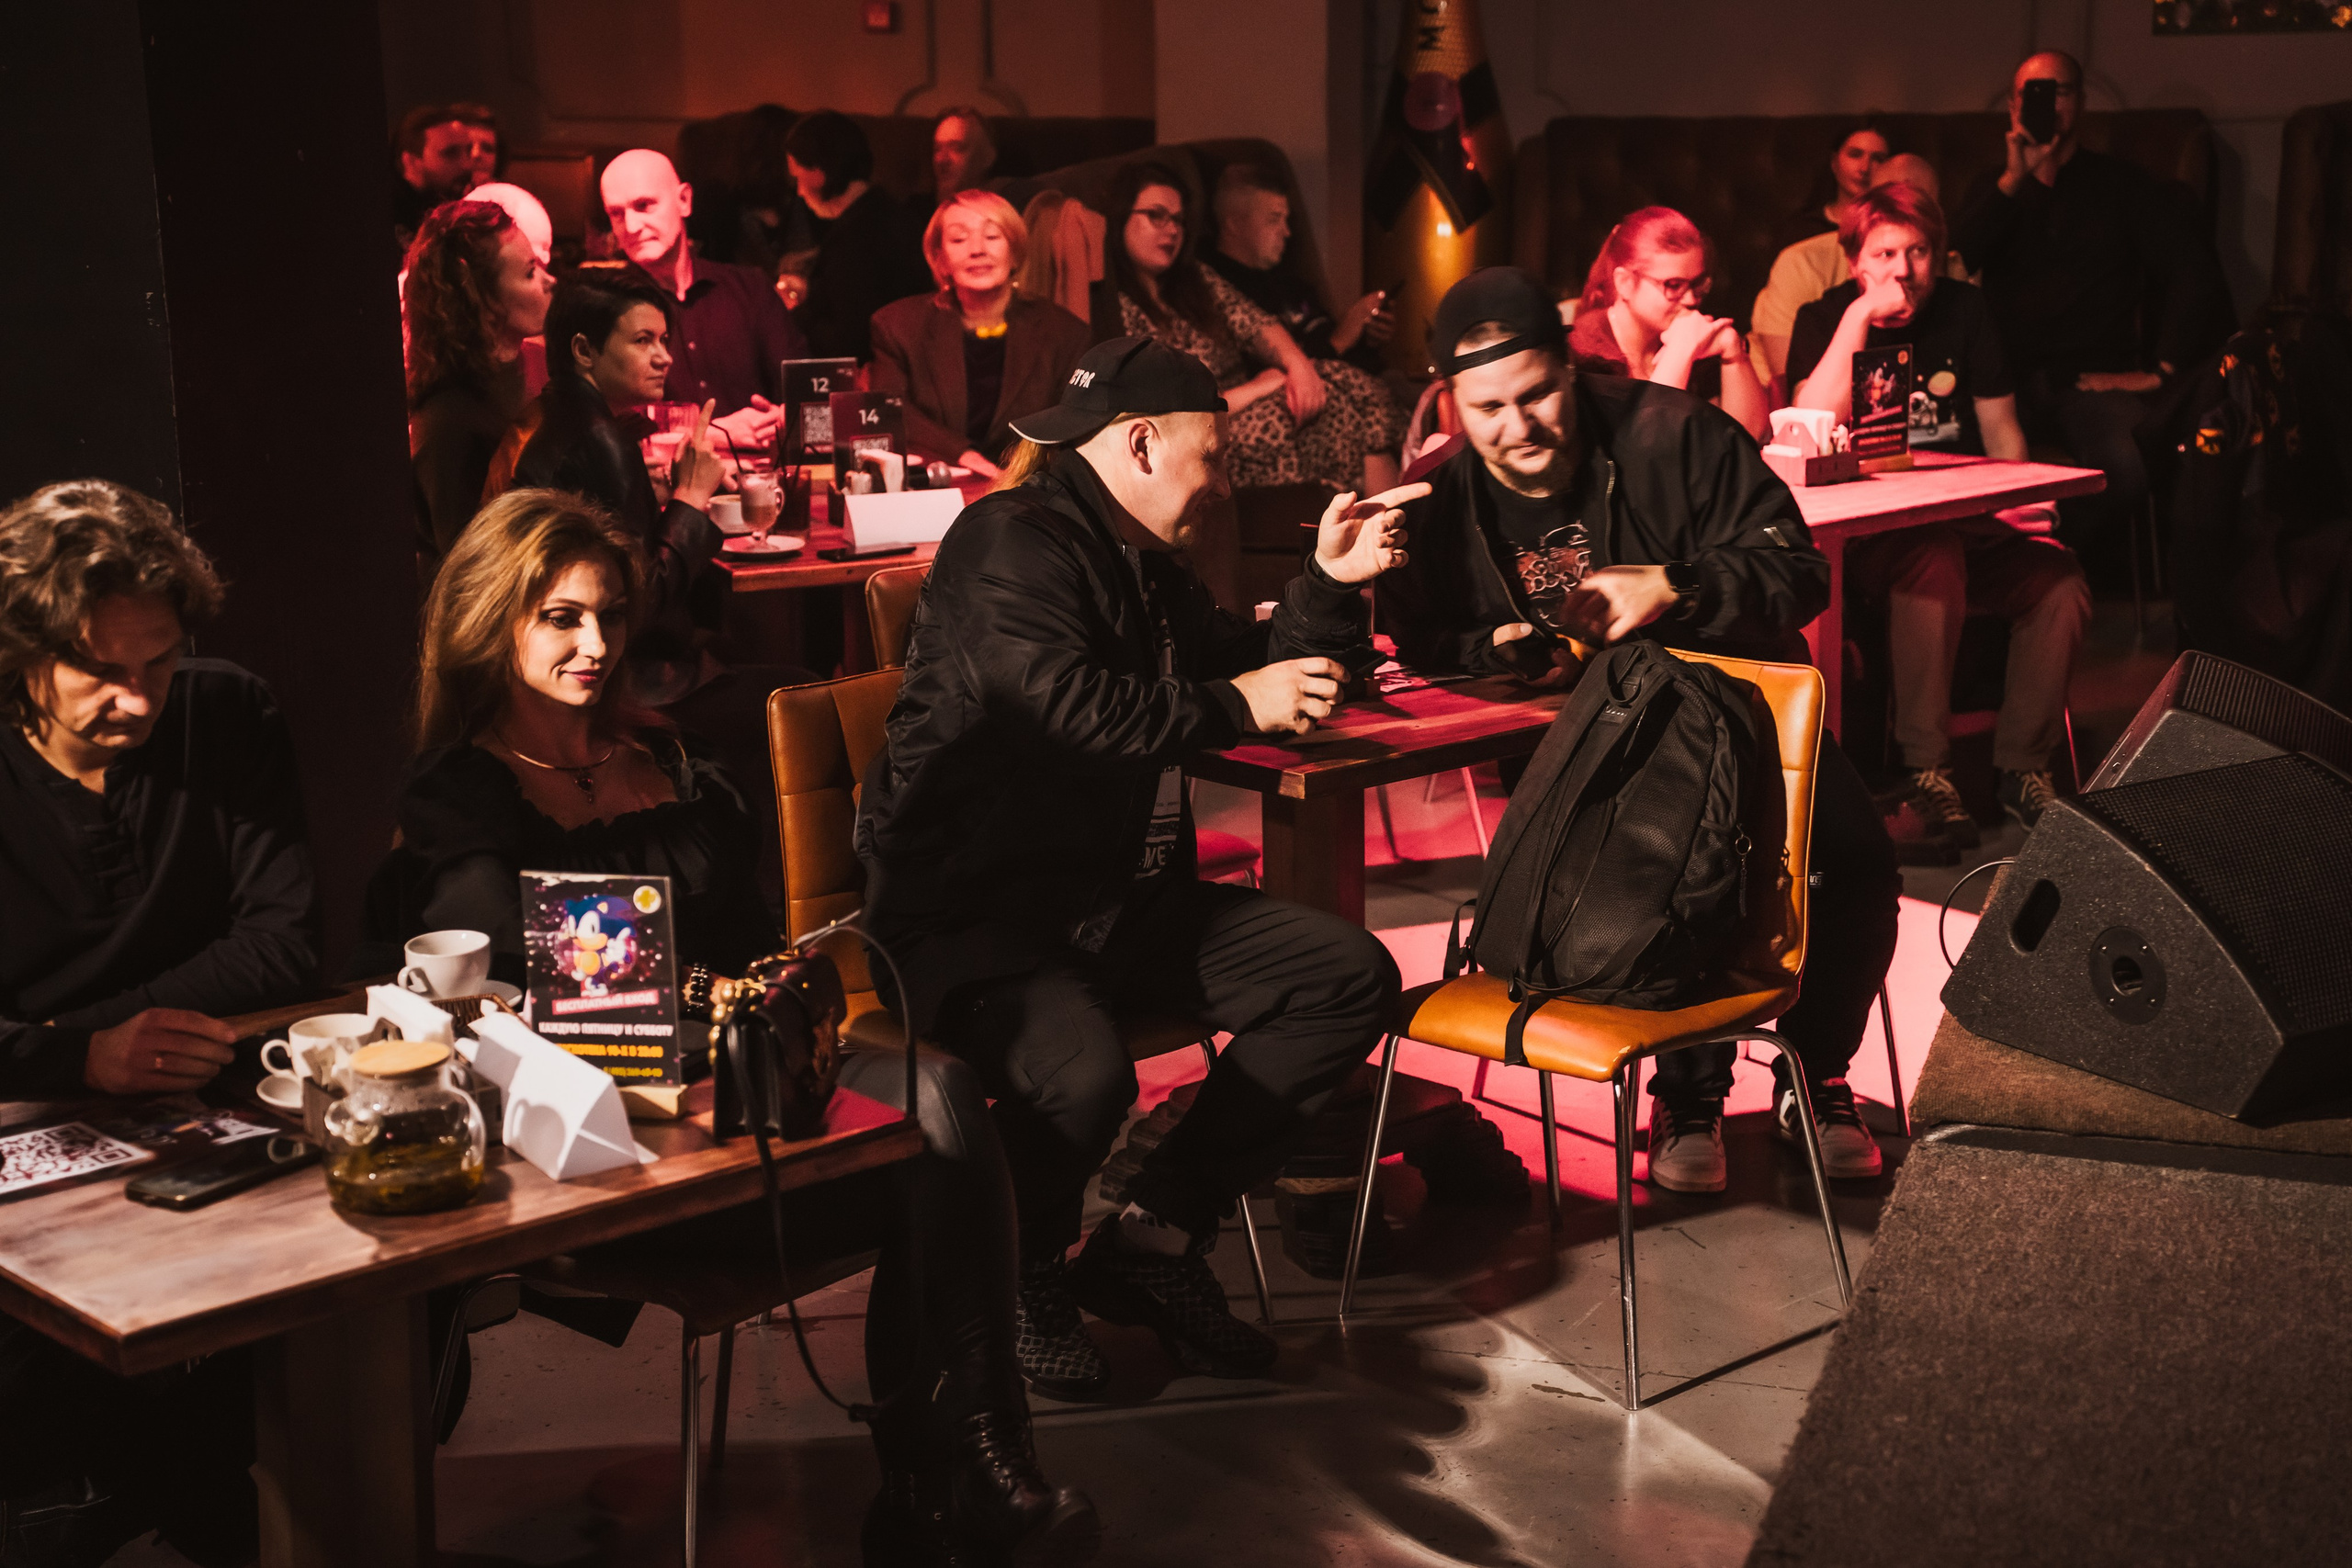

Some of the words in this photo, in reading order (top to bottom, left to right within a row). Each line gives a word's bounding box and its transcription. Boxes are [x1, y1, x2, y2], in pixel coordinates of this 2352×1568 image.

[811, 378, 829, 392] 12
[859, 409, 879, 424] 14
[538, 1021, 581, 1035] КАЖДУЮ
[582, 1022, 624, 1036] ПЯТНИЦУ
[625, 1023, 633, 1035] И
[634, 1023, 673, 1037] СУББОТУ
